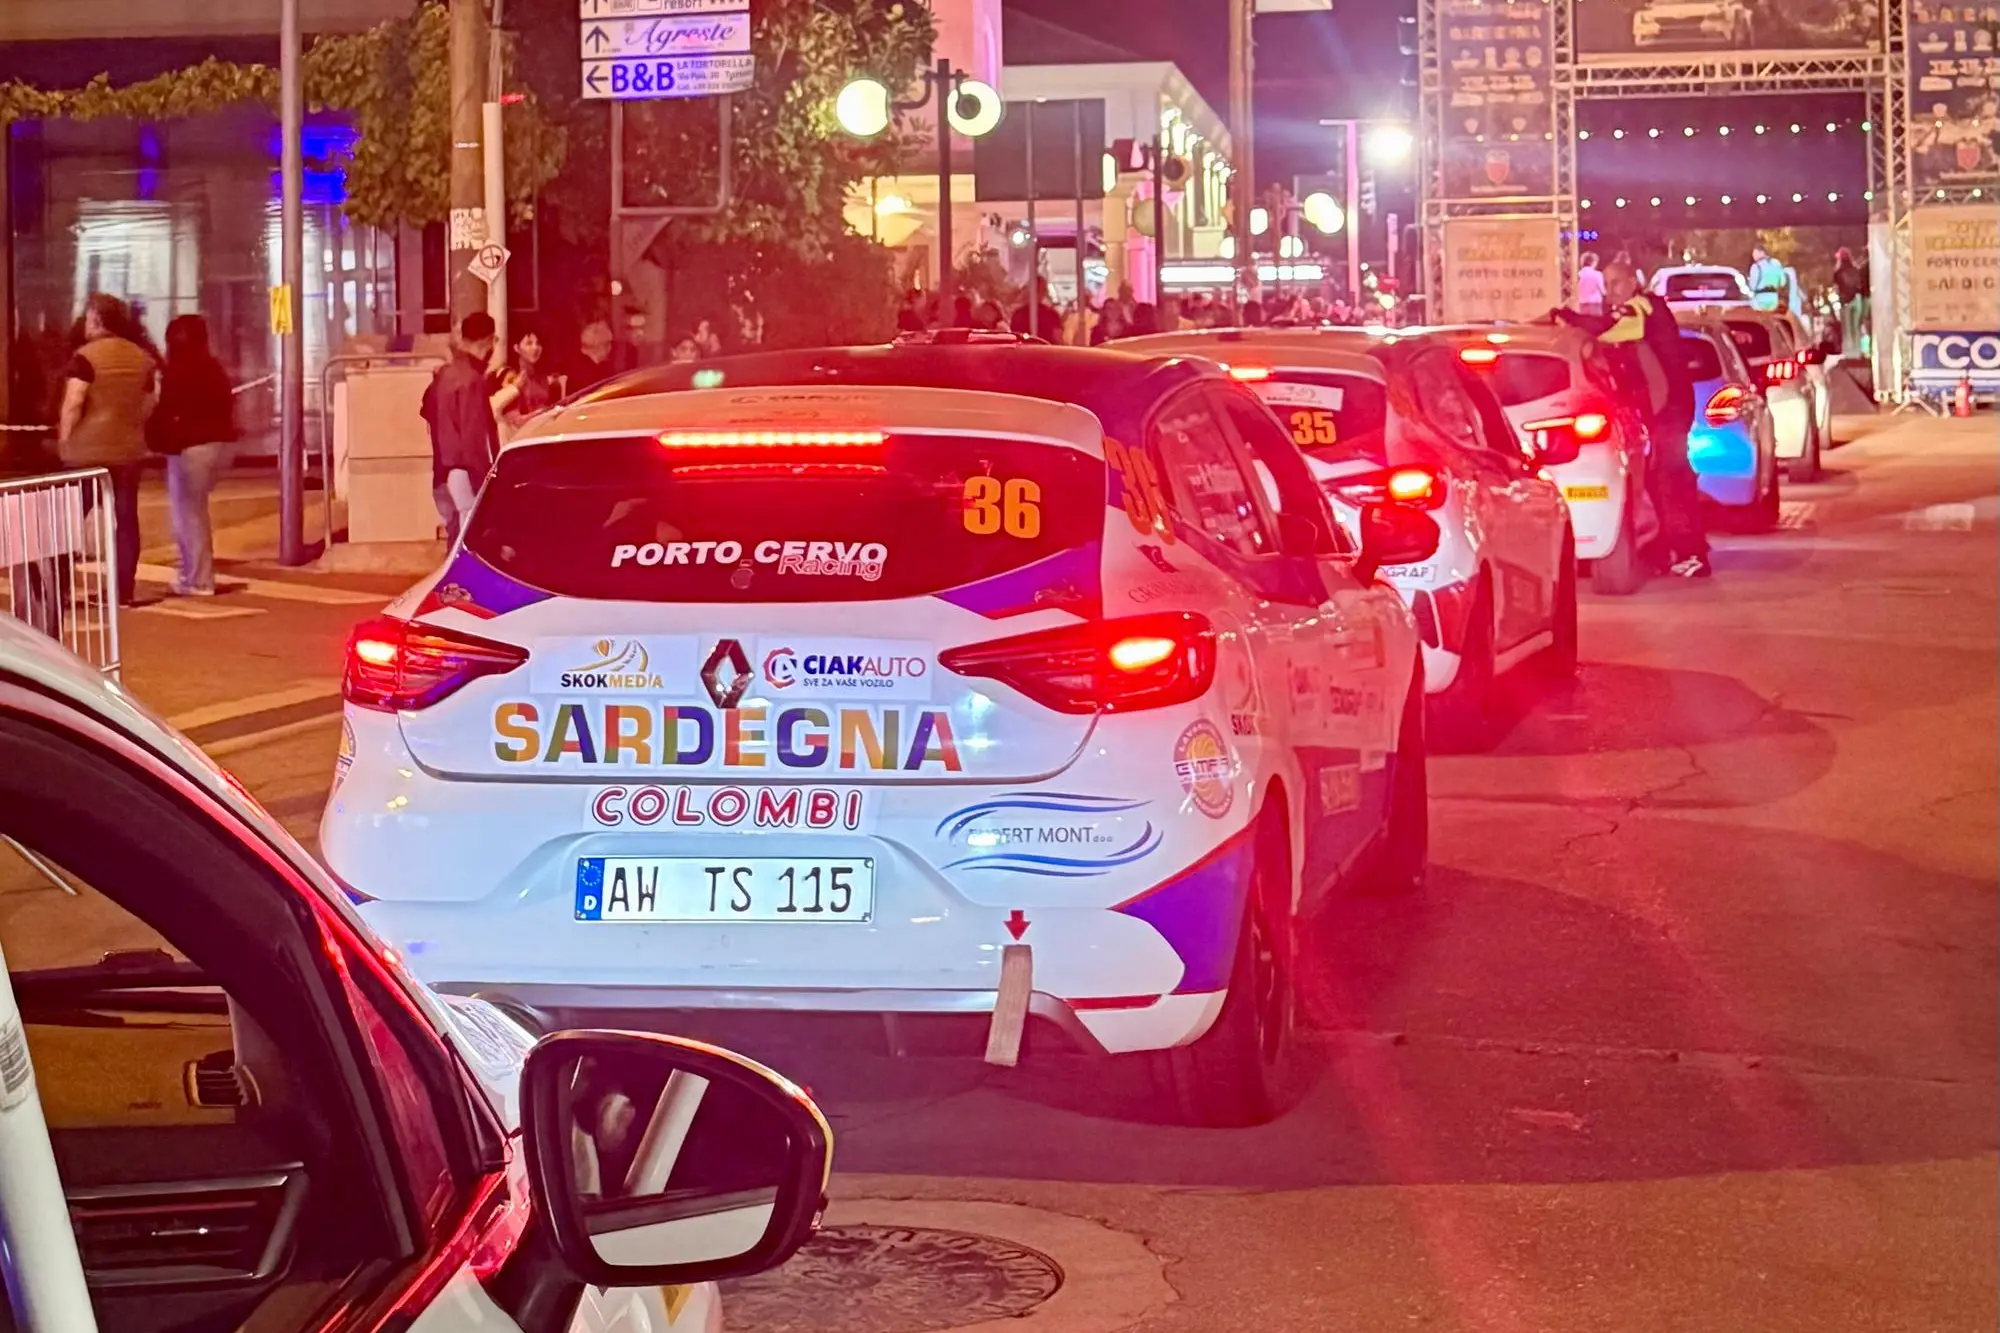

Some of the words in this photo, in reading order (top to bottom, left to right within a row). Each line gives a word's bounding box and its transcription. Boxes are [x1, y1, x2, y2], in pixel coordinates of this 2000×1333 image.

[611, 62, 675, 93] B&B
[1291, 411, 1337, 445] 35
[964, 476, 1041, 538] 36
[611, 540, 743, 567] PORTO
[754, 540, 888, 565] CERVO
[777, 553, 885, 582] Racing
[803, 678, 819, 687] SVE
[821, 678, 833, 687] ZA
[836, 677, 858, 688] VAŠE
[860, 679, 894, 687] VOZILO
[494, 702, 962, 771] SARDEGNA
[592, 784, 862, 830] COLOMBI
[1038, 827, 1094, 843] MONT
[583, 894, 598, 911] D
[608, 866, 659, 912] AW
[704, 866, 753, 912] TS
[777, 866, 854, 912] 115
